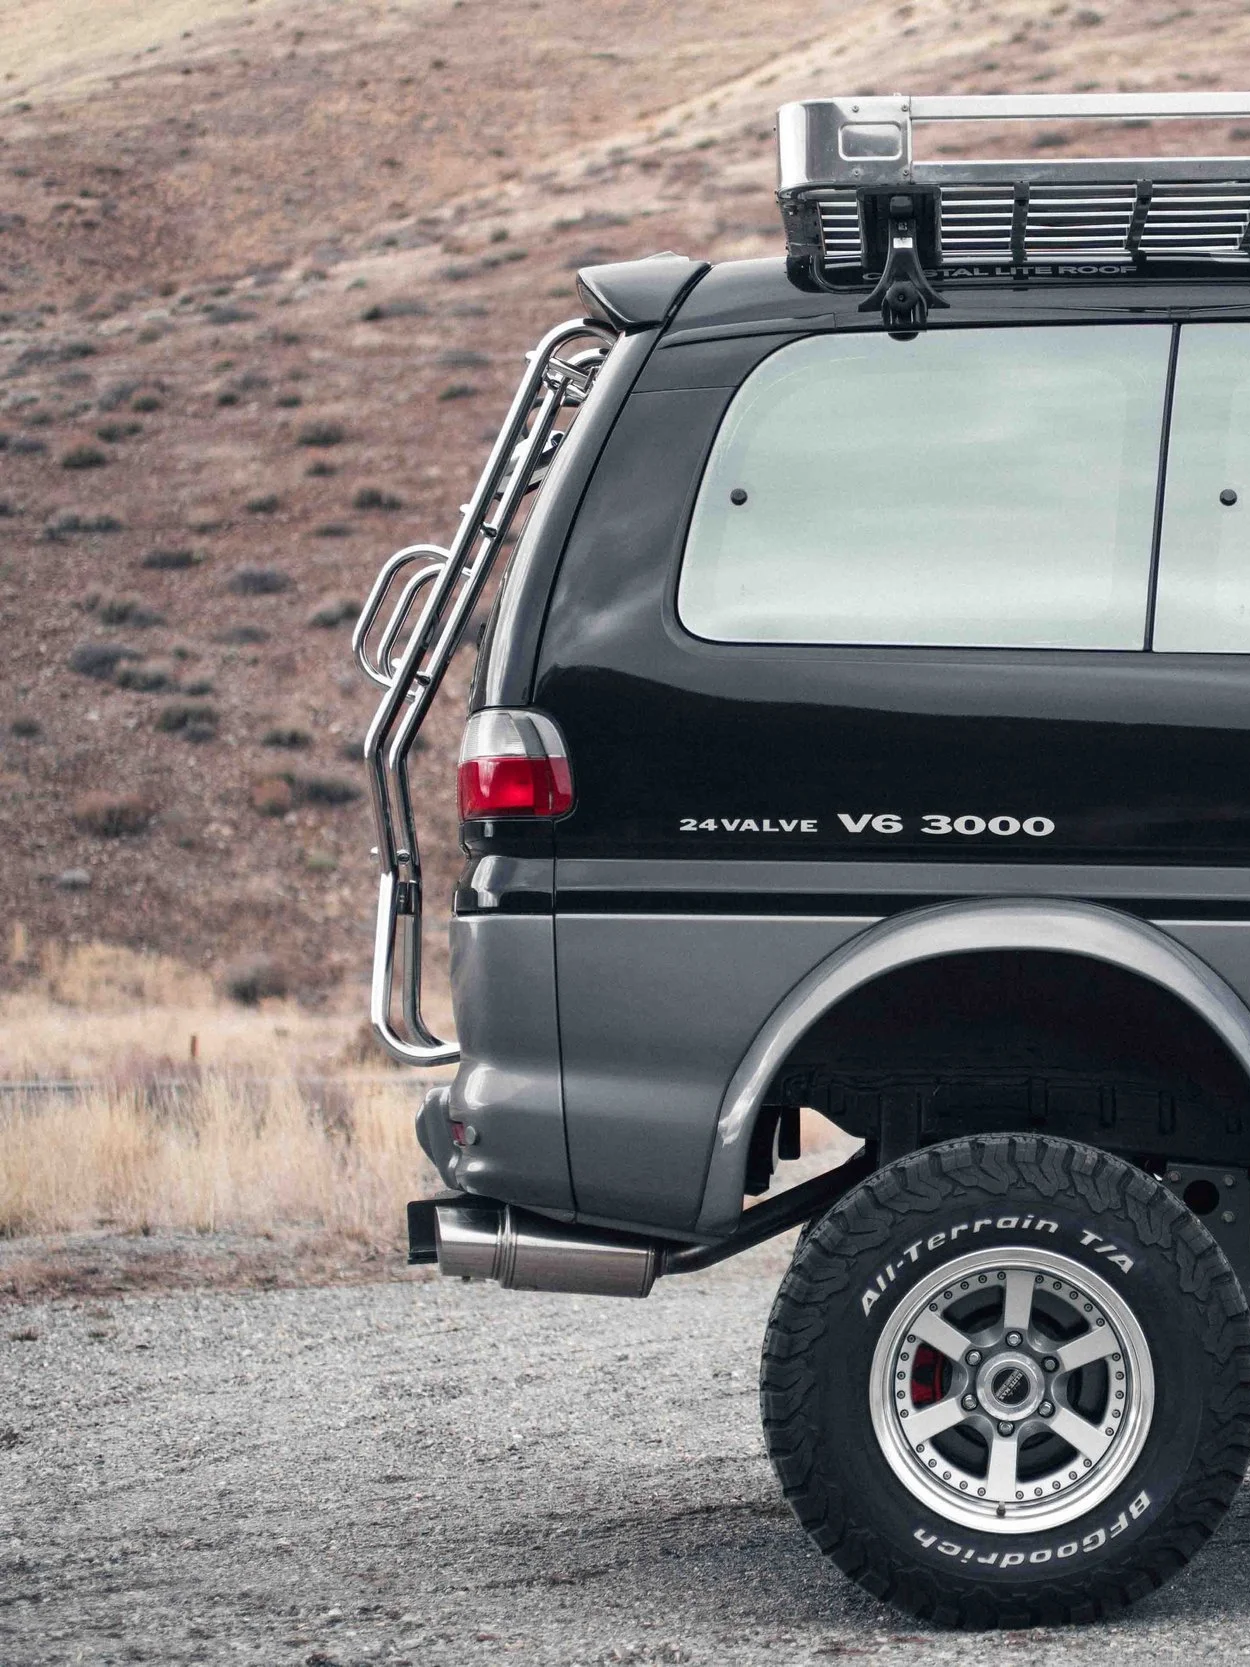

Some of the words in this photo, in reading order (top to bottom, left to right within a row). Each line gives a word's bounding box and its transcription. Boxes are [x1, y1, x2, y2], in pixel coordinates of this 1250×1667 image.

[862, 266, 989, 281] CSTAL
[995, 266, 1053, 276] LITE
[1058, 265, 1138, 275] ROOF
[837, 813, 904, 834] V6
[920, 815, 1056, 837] 3000
[861, 1214, 1058, 1317] All-Terrain
[1080, 1229, 1135, 1274] T/A
[913, 1490, 1152, 1569] BFGoodrich
